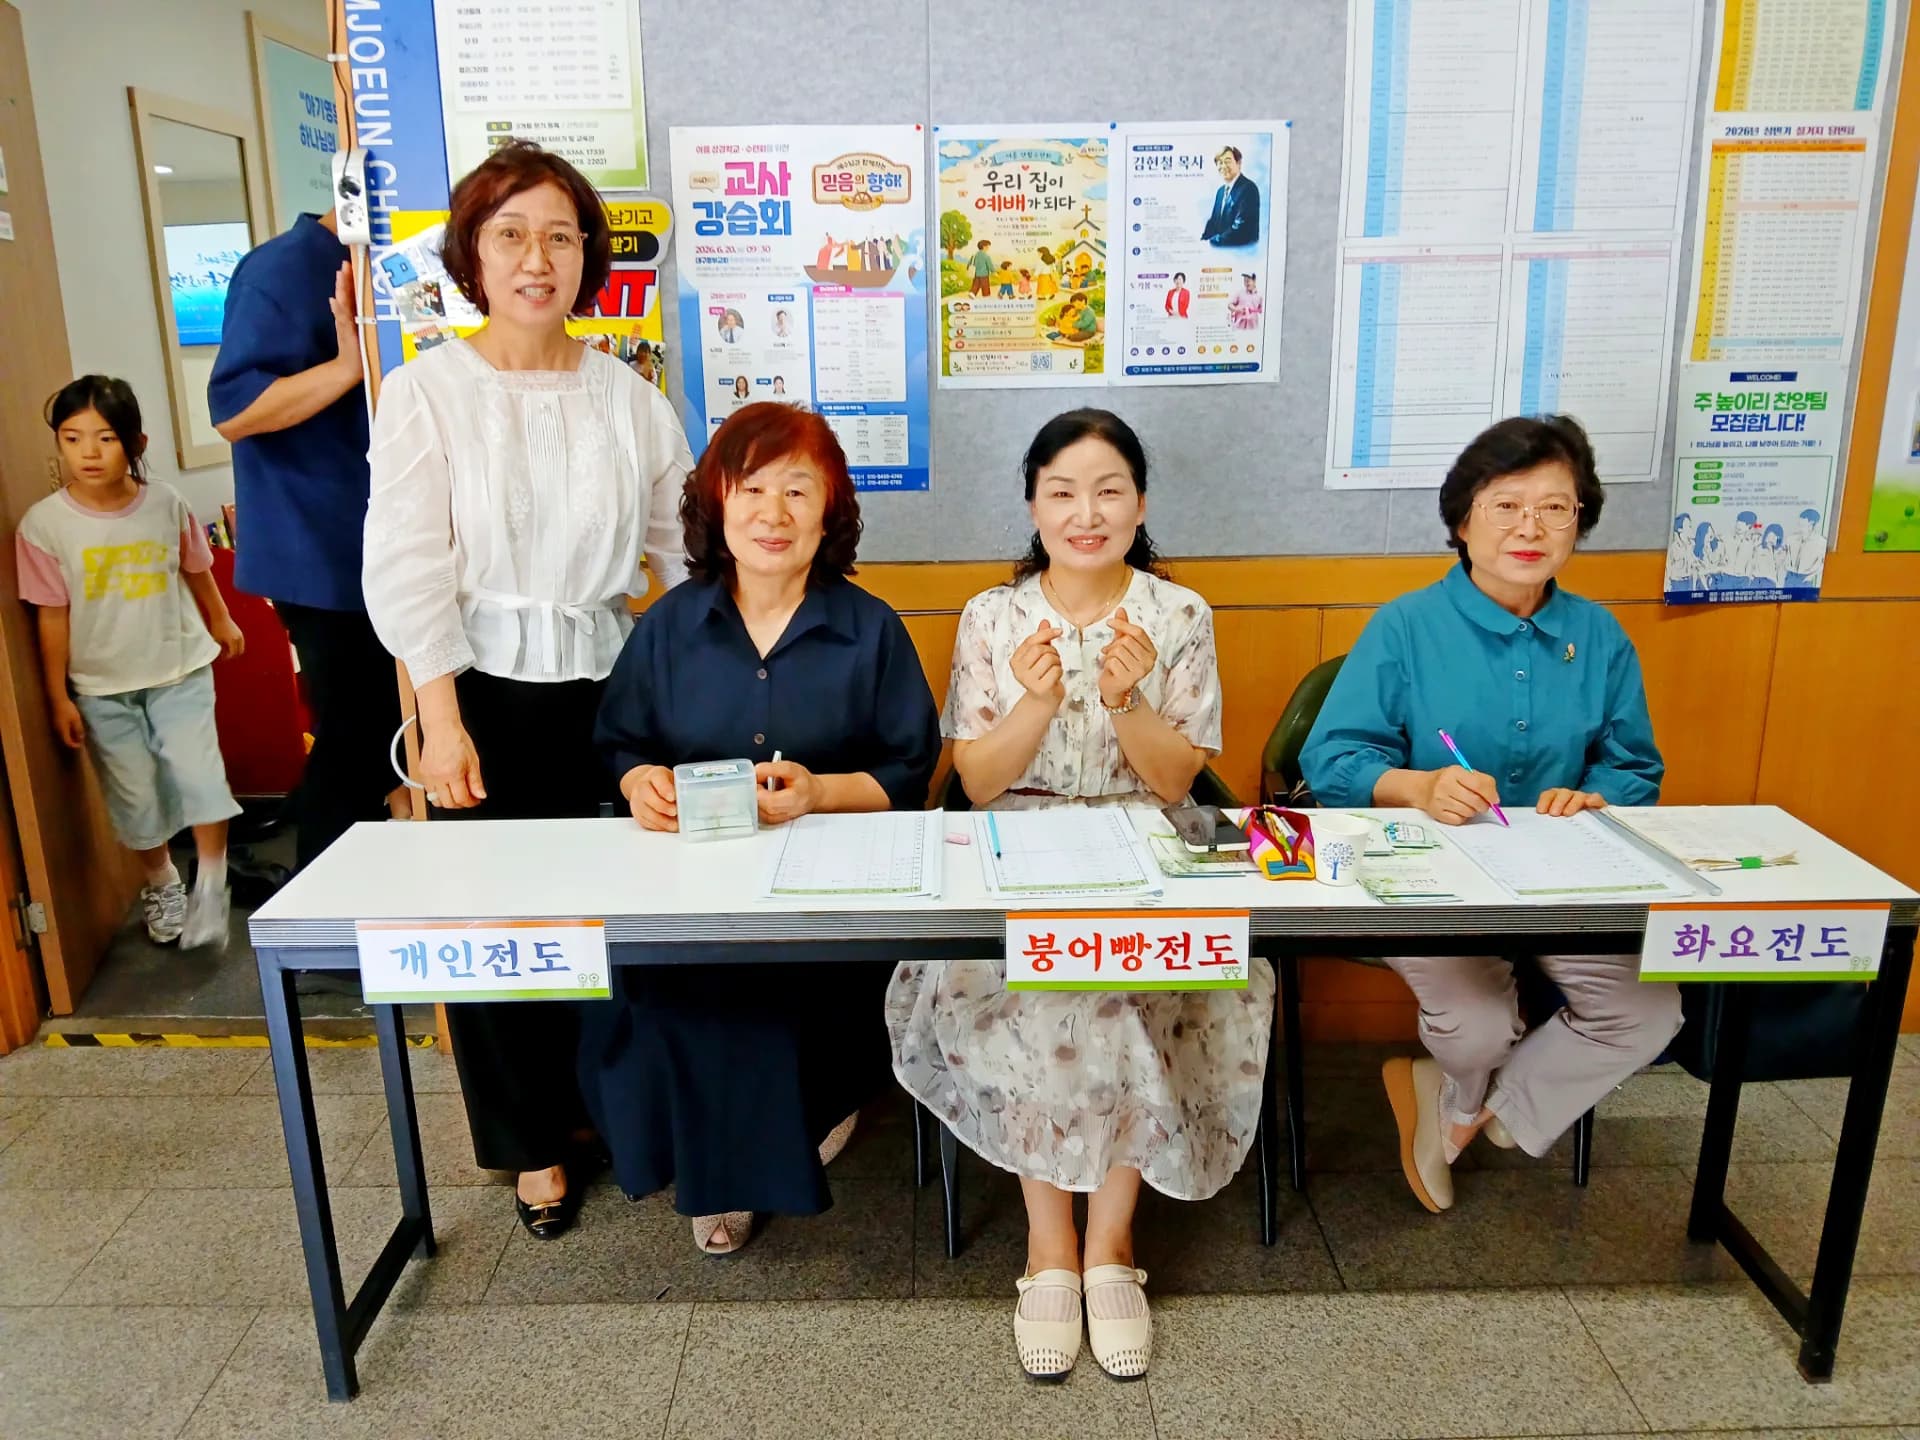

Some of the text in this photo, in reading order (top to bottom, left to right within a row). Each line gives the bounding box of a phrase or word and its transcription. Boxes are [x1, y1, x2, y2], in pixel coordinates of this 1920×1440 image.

[724, 161, 792, 196] 교사
[822, 172, 902, 192] 믿음의 항해
[983, 170, 1063, 193] 우리 집이
[975, 194, 1077, 212] 예배가 되다
[609, 209, 654, 226] 남기고
[692, 198, 792, 236] 강습회
[1693, 391, 1828, 412] 주 높이리 찬양팀
[1710, 413, 1807, 432] 모집합니다!
[1022, 931, 1240, 972] 붕어빵전도
[1671, 923, 1851, 963] 화요전도
[389, 939, 572, 979] 개인전도
